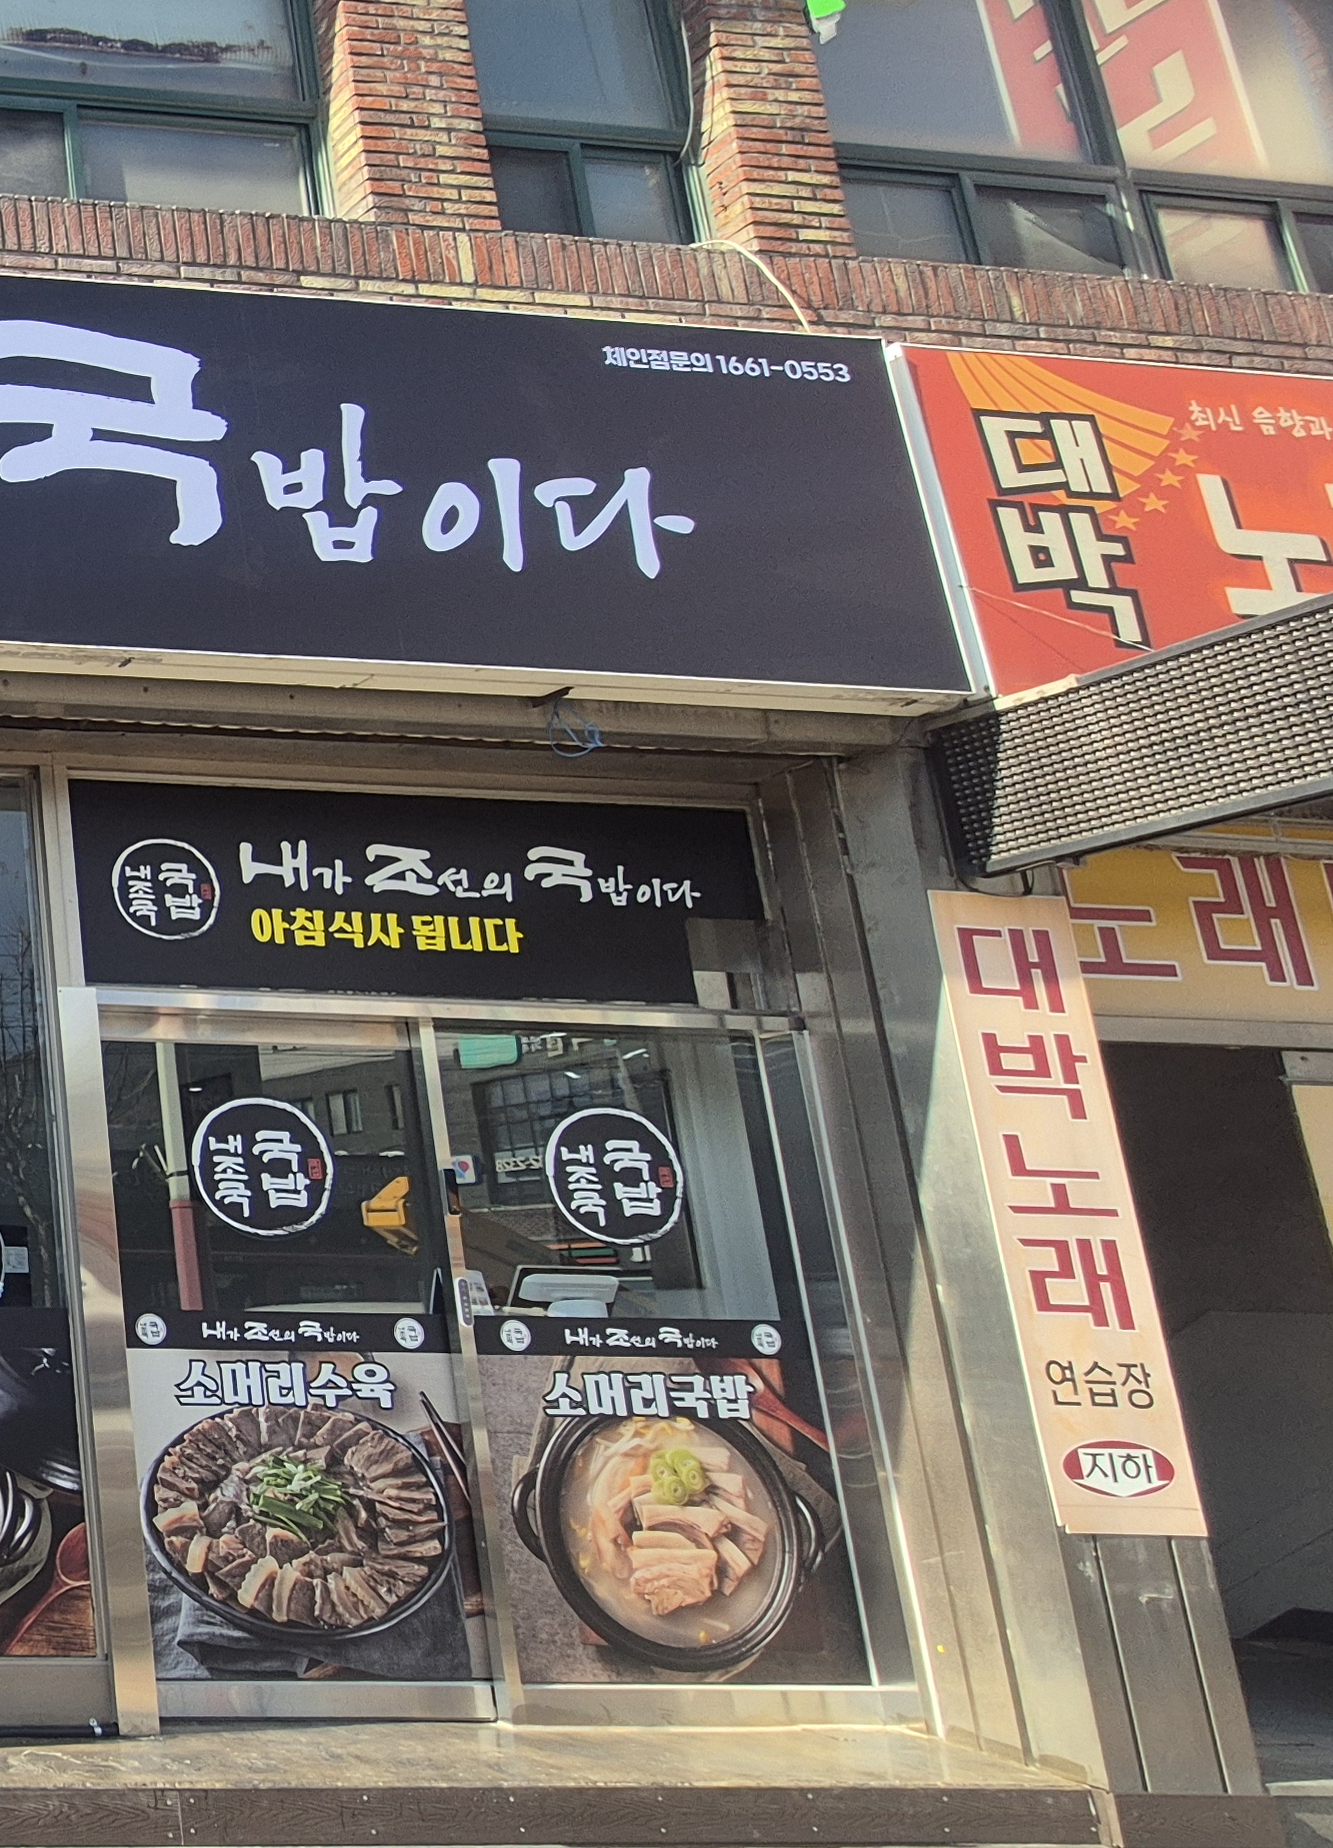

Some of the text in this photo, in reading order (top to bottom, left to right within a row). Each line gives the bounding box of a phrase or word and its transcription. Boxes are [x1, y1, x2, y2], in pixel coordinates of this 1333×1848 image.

[602, 346, 851, 383] 체인점문의 1661-0553
[1189, 400, 1333, 440] 최신 음향과
[975, 411, 1146, 646] 대박
[124, 864, 158, 927] 내조국
[158, 862, 203, 921] 국밥
[239, 840, 701, 909] 내가 조선의 국밥이다
[251, 908, 524, 953] 아침식사 됩니다
[208, 1134, 252, 1217] 내조국
[252, 1130, 311, 1208] 국밥
[560, 1144, 607, 1227] 내조국
[603, 1140, 663, 1217] 국밥
[178, 1361, 395, 1408] 소머리수육
[544, 1372, 755, 1418] 소머리국밥
[1045, 1360, 1154, 1409] 연습장
[1082, 1452, 1153, 1484] 지하
